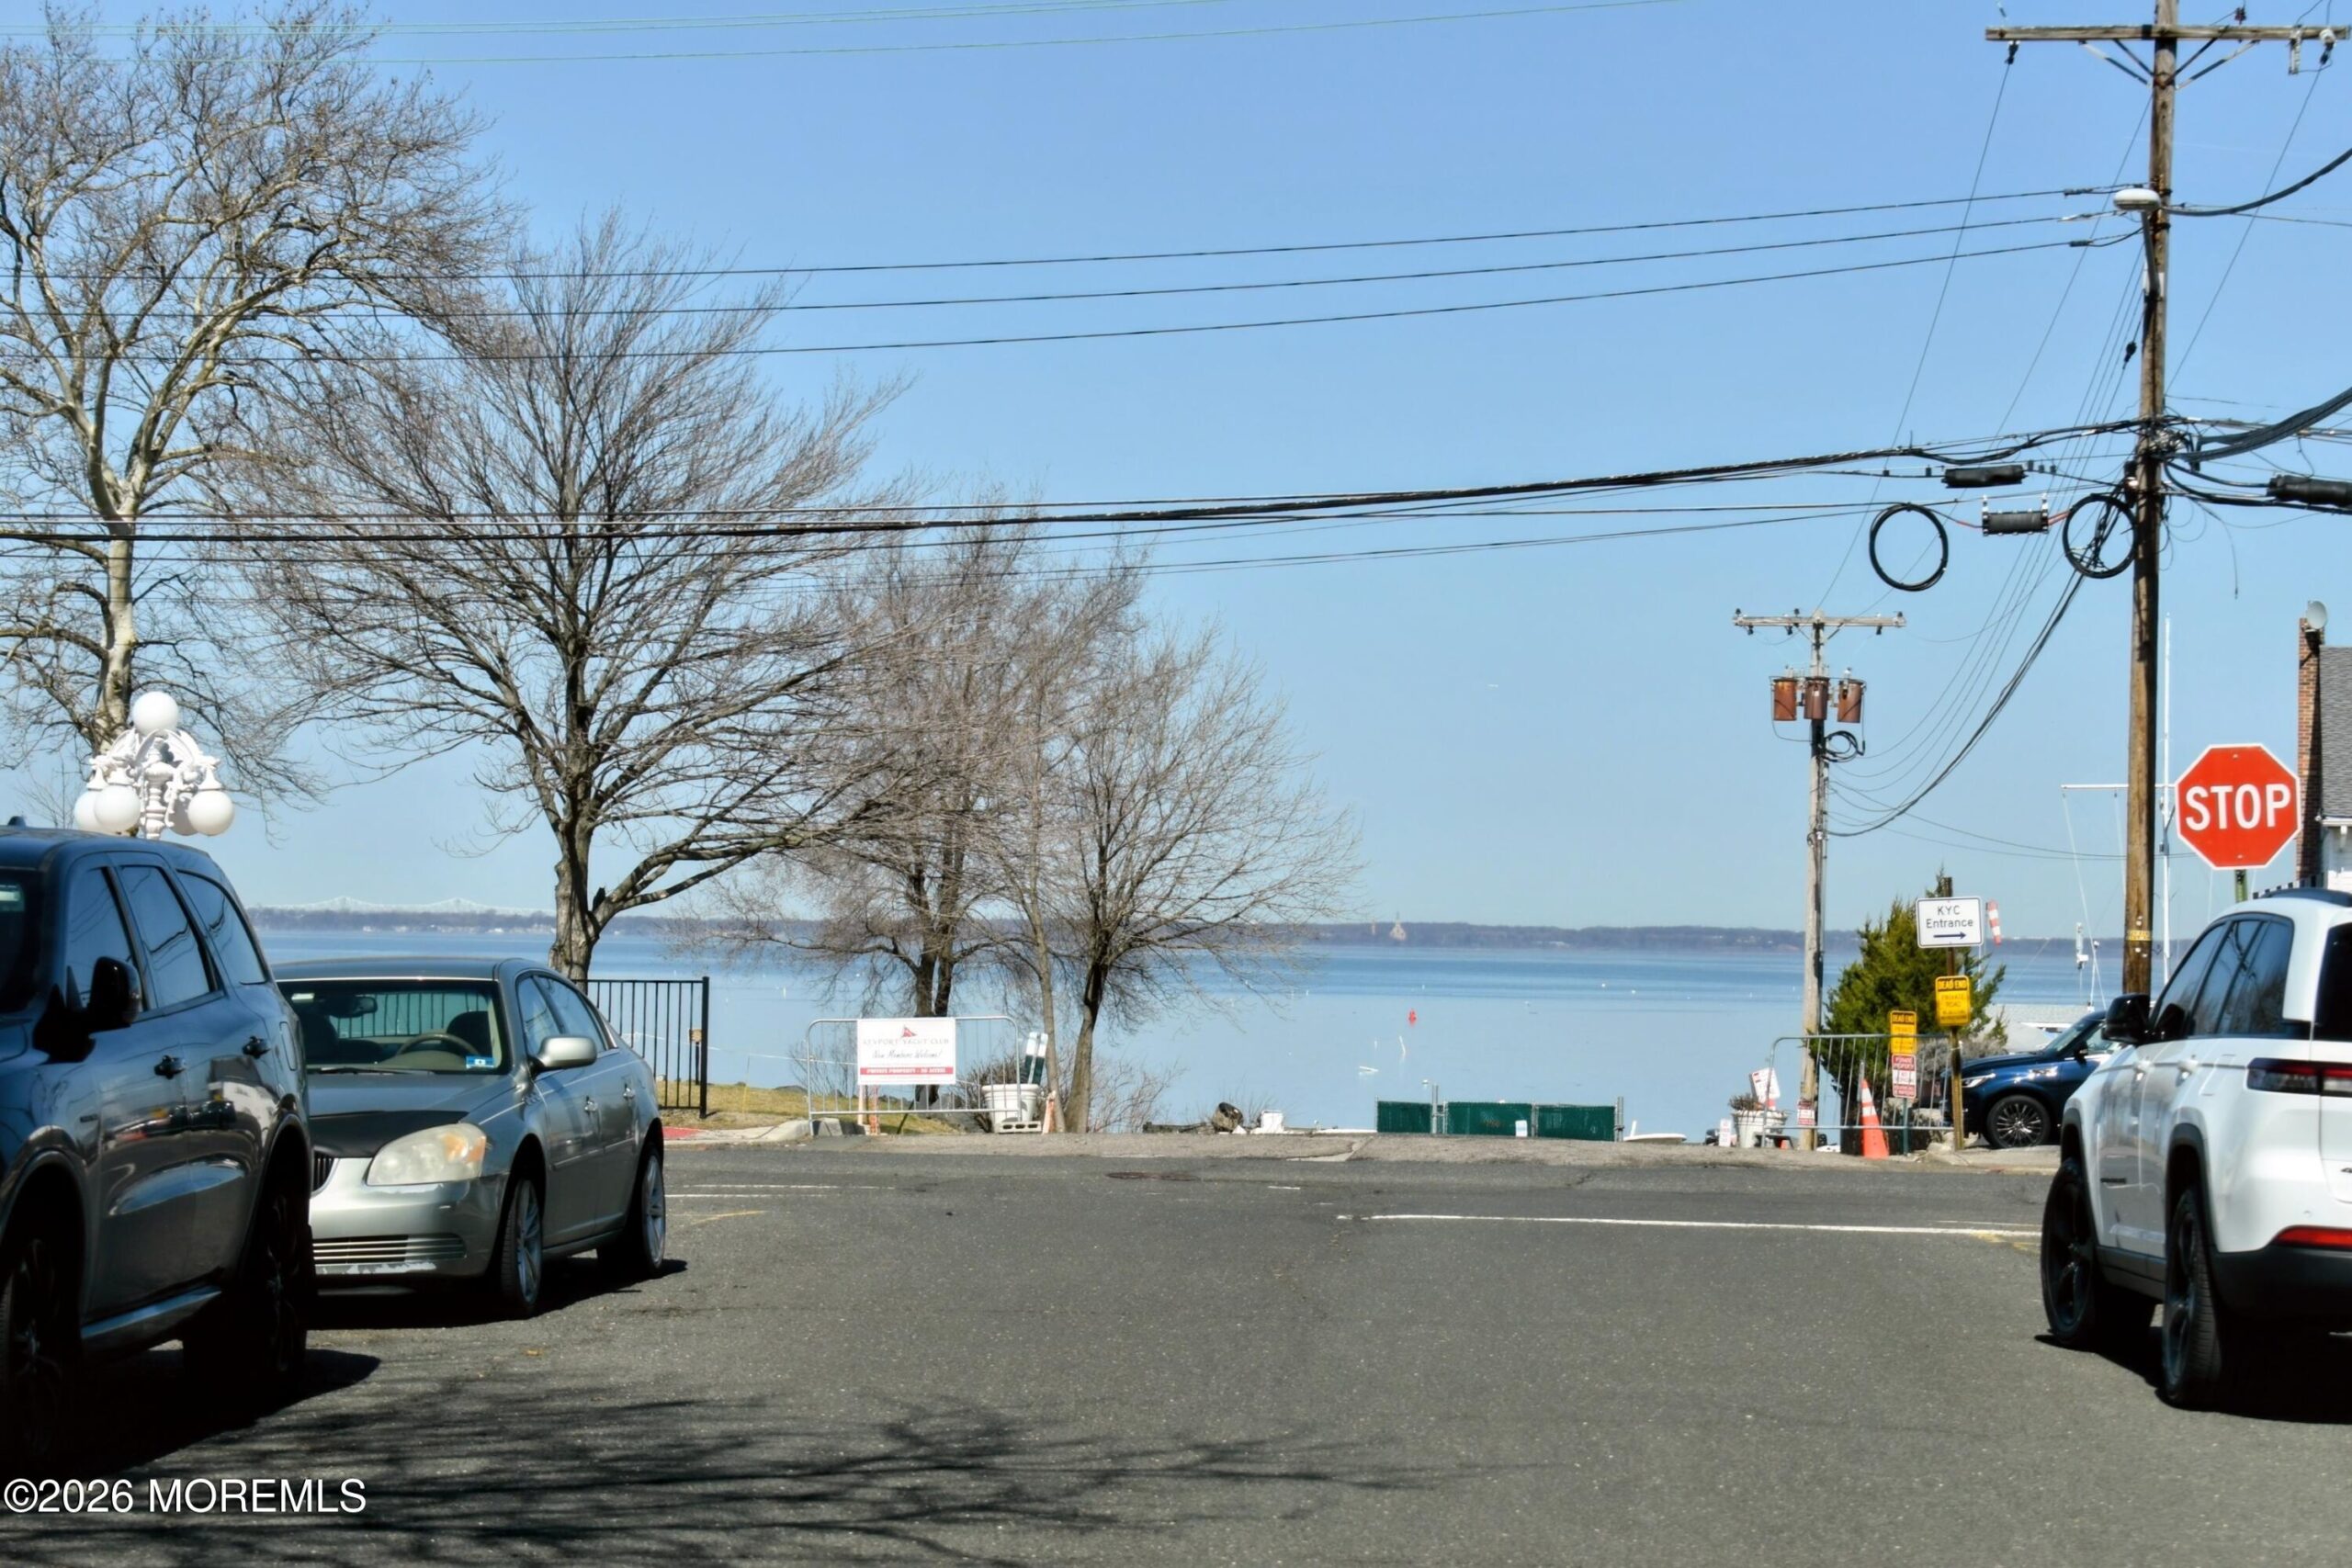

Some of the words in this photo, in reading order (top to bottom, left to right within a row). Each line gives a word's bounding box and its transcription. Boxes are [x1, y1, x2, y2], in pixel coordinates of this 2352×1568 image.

[2186, 784, 2291, 831] STOP
[1937, 905, 1960, 915] KYC
[1926, 919, 1973, 929] Entrance
[1938, 979, 1954, 990] DEAD
[1955, 979, 1967, 989] END
[1893, 1014, 1905, 1022] DEAD
[1905, 1014, 1915, 1022] END
